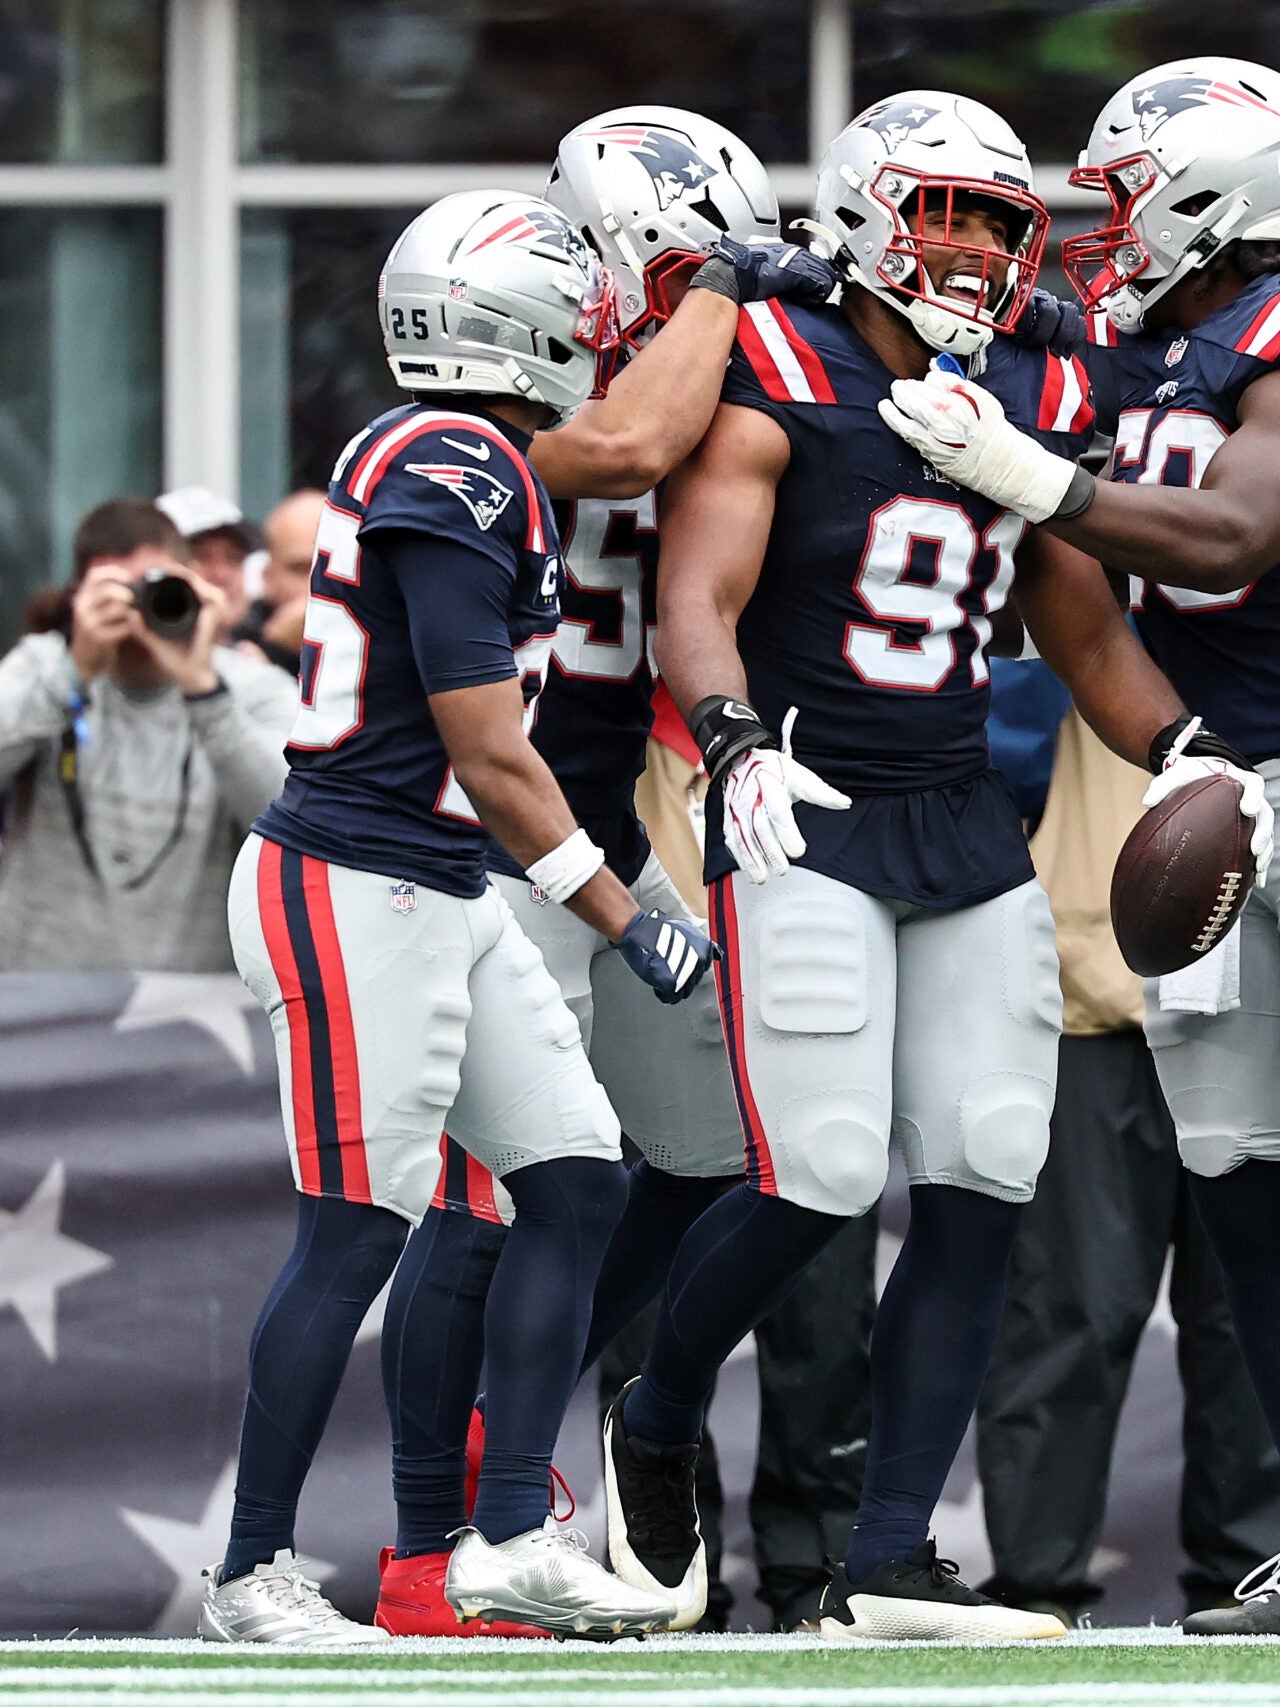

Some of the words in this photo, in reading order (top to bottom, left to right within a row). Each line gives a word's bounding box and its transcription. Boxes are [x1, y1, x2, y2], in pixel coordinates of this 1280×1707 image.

[391, 308, 429, 341] 25
[550, 491, 660, 685] 5
[842, 493, 1032, 693] 91
[1164, 828, 1192, 873] NATIONAL
